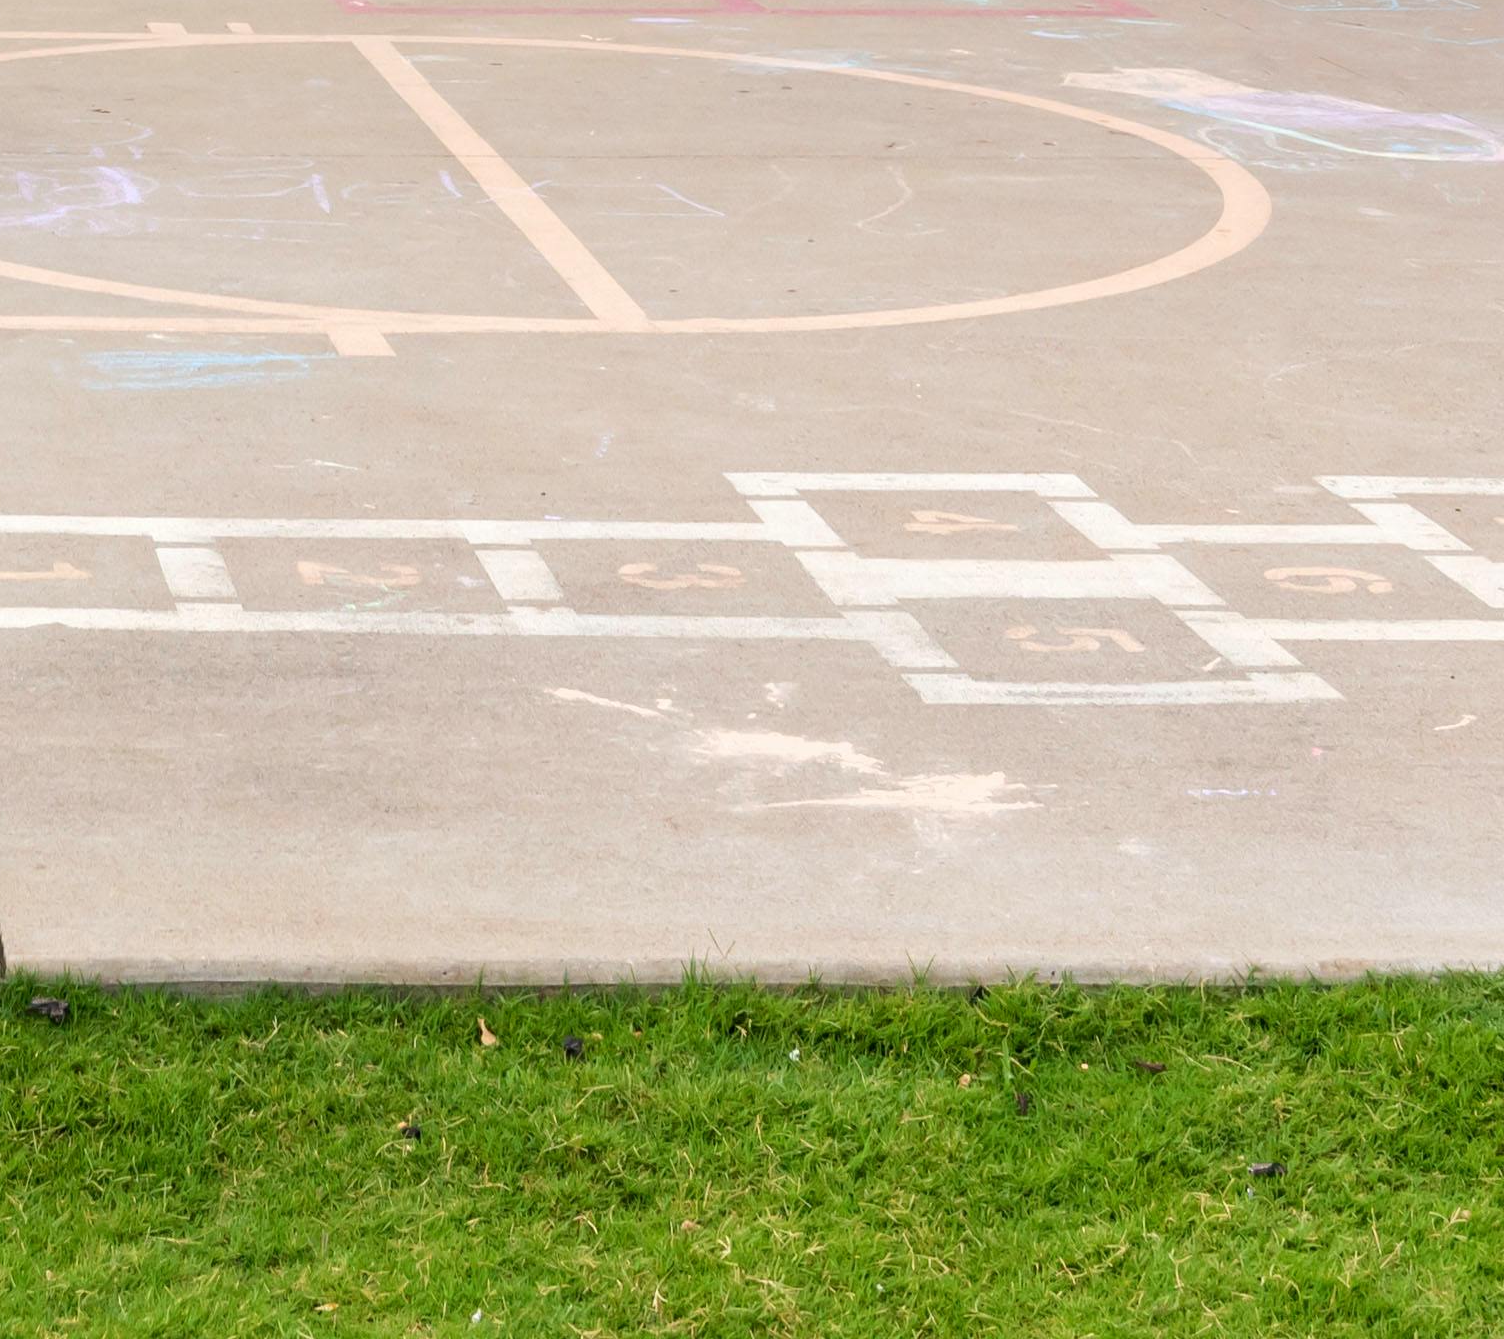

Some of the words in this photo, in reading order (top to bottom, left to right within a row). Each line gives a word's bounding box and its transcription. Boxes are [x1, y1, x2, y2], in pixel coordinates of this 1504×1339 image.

[903, 510, 1020, 536] 4
[296, 560, 423, 586] 2
[618, 561, 747, 590] 3
[1263, 566, 1394, 595] 6
[1004, 625, 1146, 654] 5
